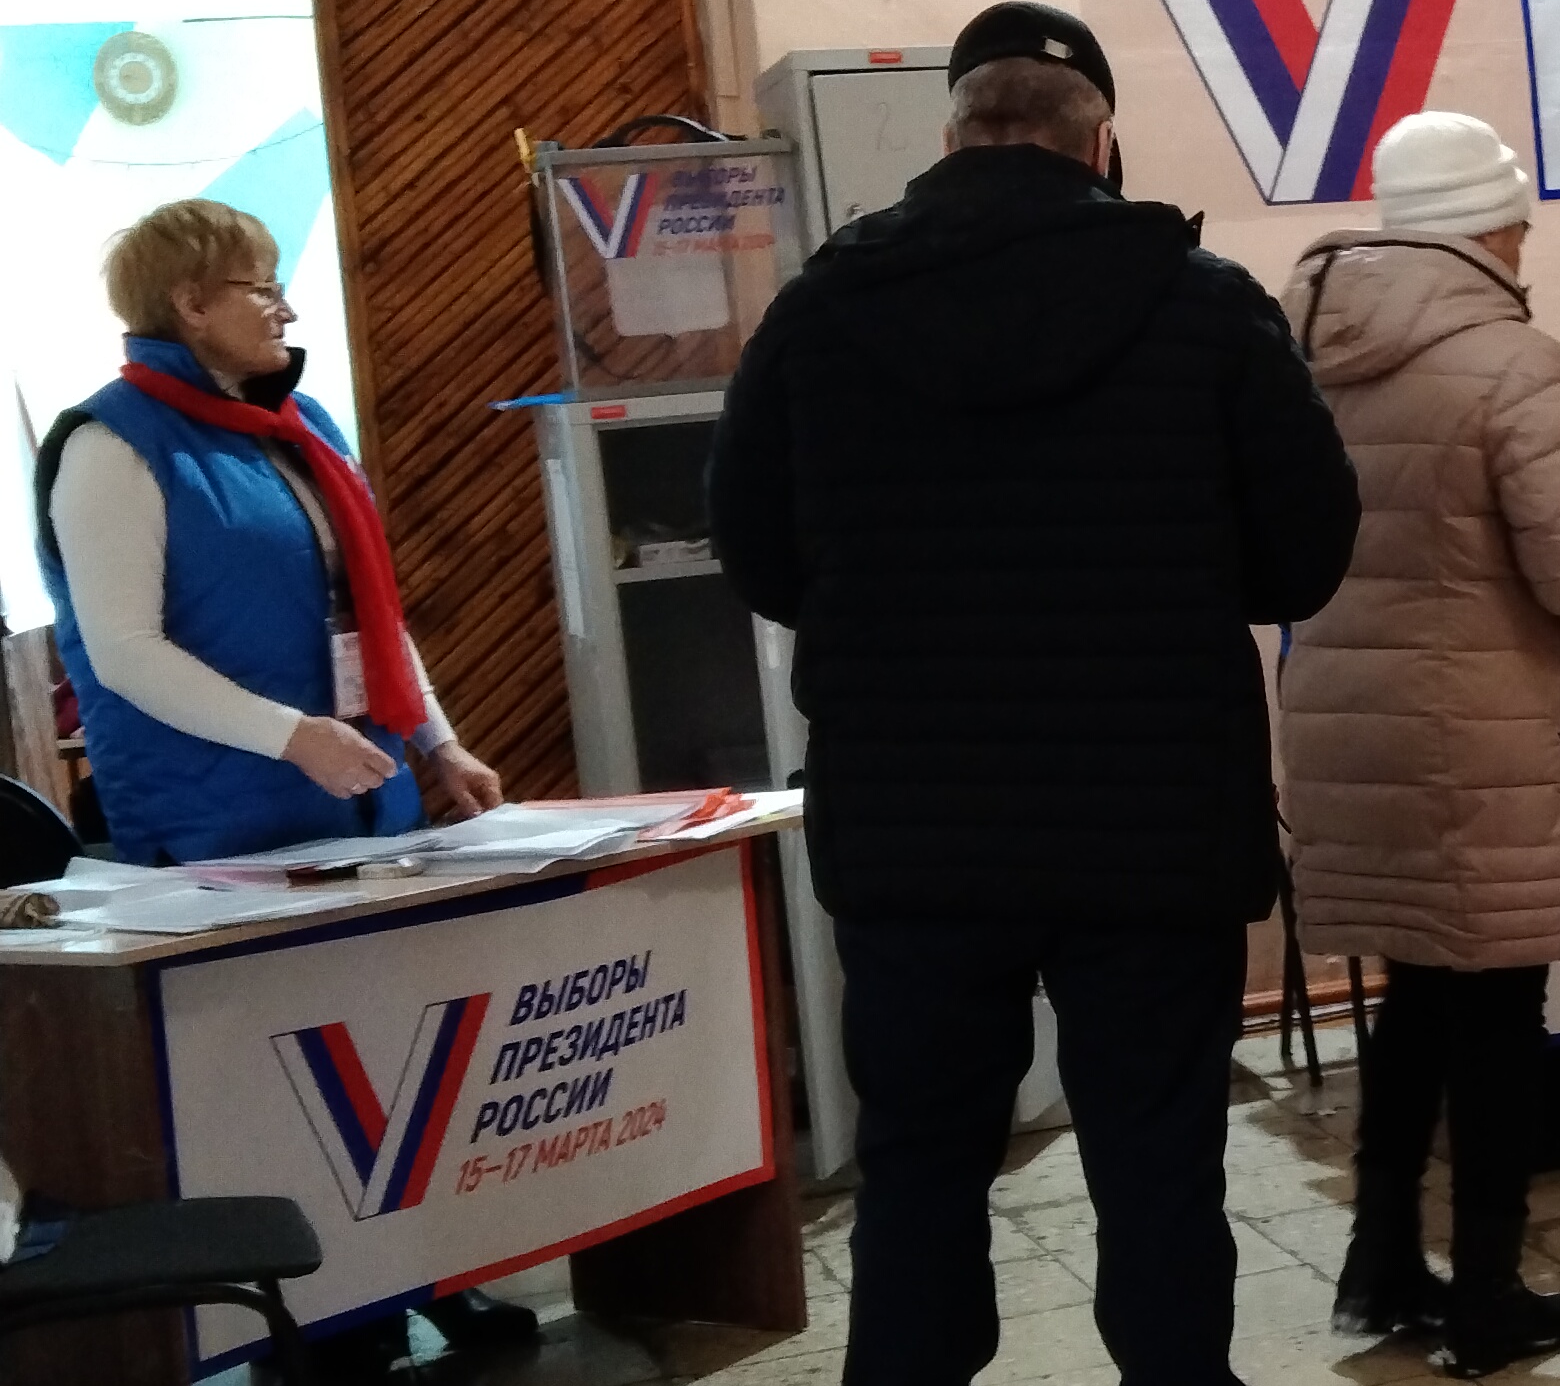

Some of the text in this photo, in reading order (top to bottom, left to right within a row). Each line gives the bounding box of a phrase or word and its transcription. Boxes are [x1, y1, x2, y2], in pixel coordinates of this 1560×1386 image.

[657, 214, 736, 235] РОССИИ
[509, 950, 651, 1026] ВЫБОРЫ
[489, 989, 687, 1084] ПРЕЗИДЕНТА
[469, 1068, 613, 1142] РОССИИ
[532, 1118, 613, 1173] МАРТА
[616, 1099, 667, 1146] 2024
